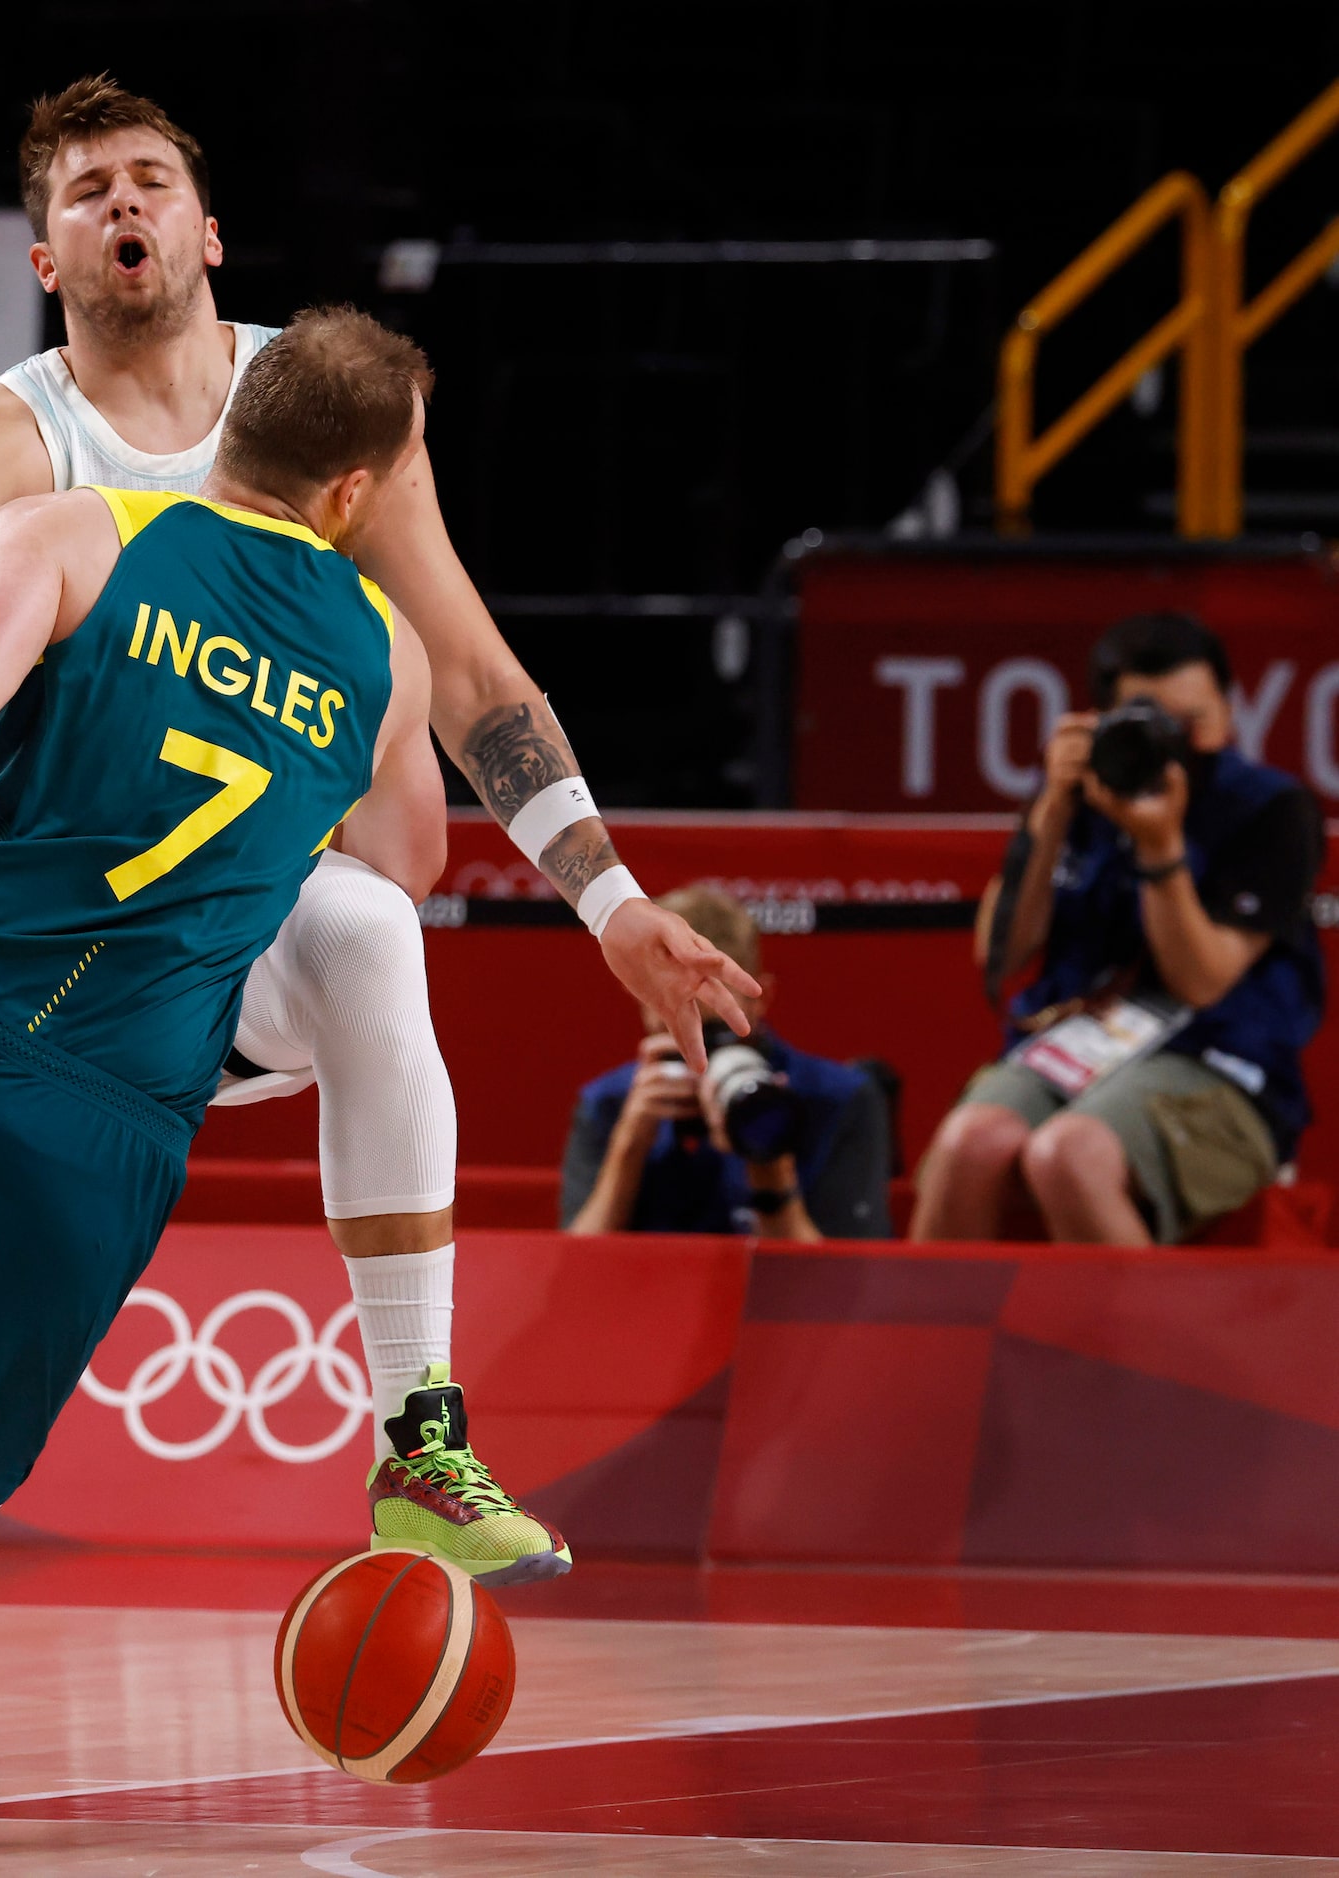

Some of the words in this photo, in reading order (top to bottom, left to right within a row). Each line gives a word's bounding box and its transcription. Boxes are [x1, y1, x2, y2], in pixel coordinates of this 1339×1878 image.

[127, 602, 345, 748] INGLES
[104, 727, 273, 902] 7
[569, 788, 586, 802] KT
[475, 1675, 502, 1724] FIBA
